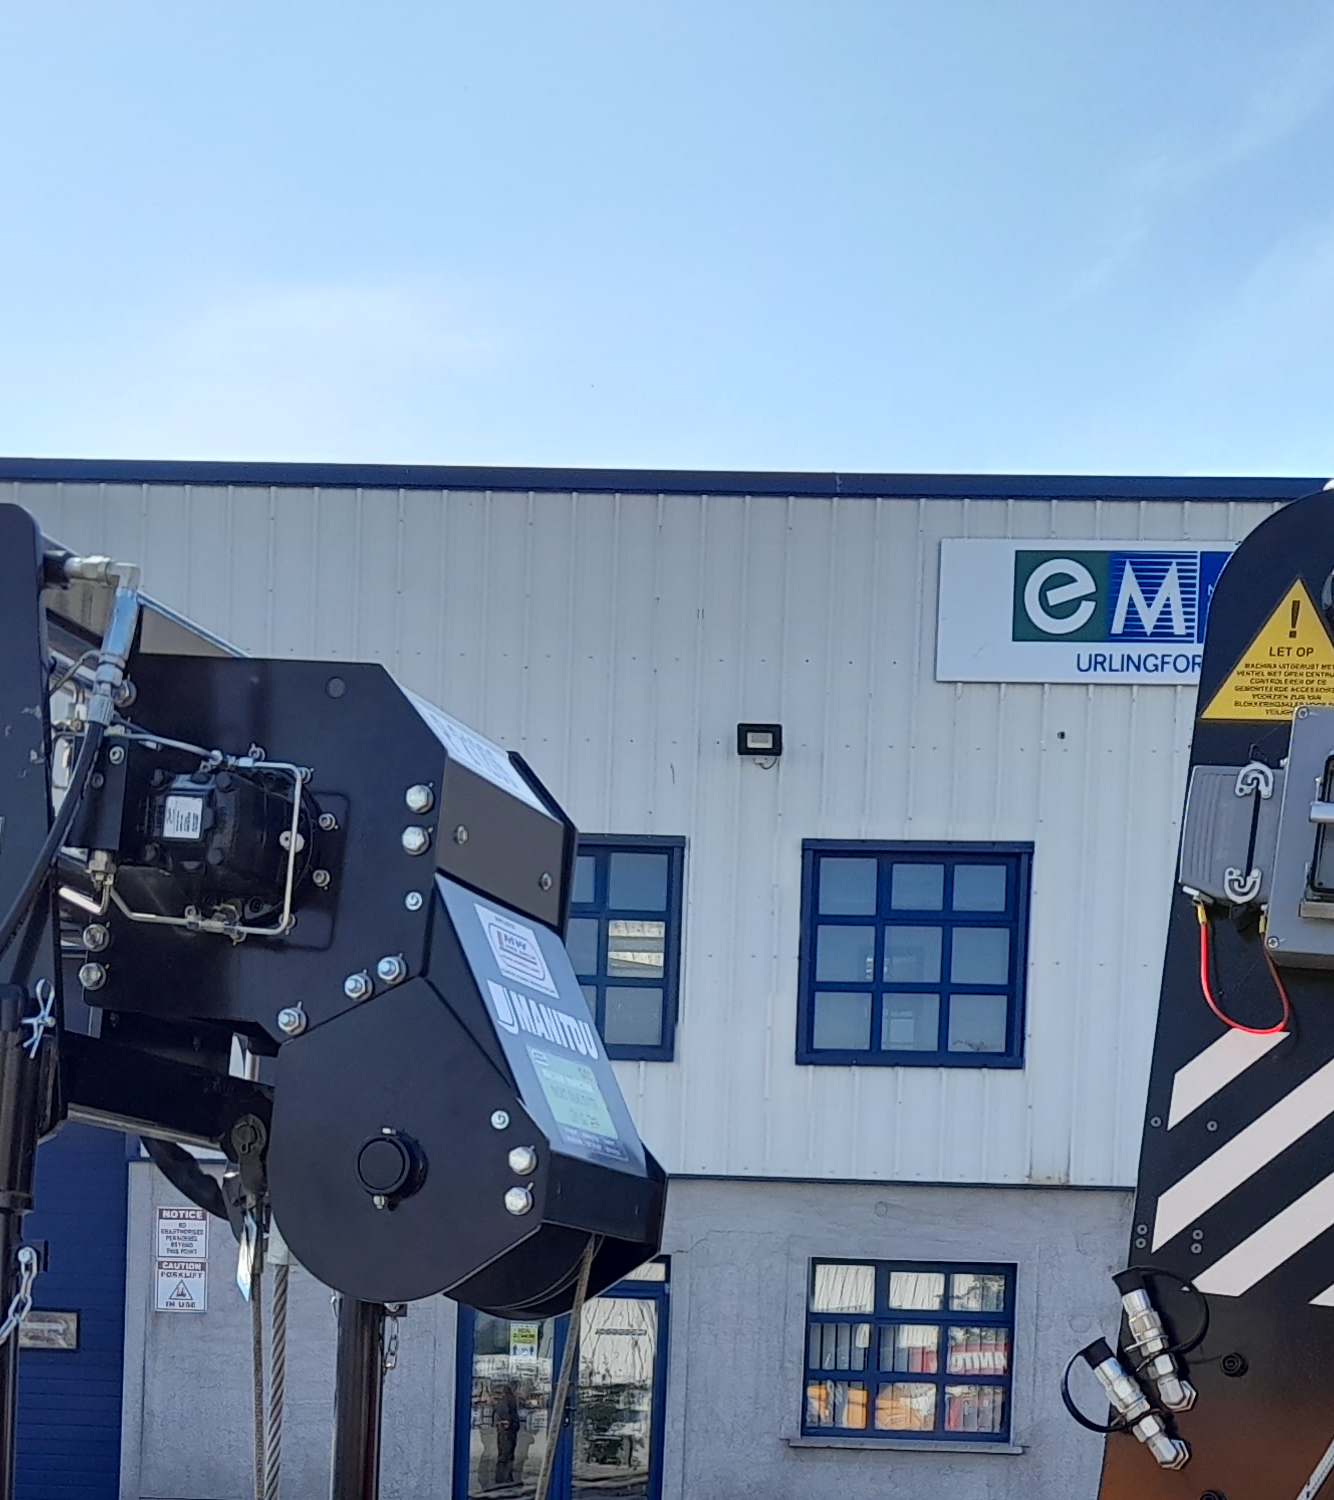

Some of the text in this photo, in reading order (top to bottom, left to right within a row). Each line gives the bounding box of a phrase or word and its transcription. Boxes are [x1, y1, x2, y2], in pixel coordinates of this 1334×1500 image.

[1269, 647, 1314, 657] LET OP
[509, 989, 599, 1060] MANITOU
[163, 1210, 203, 1219] NOTICE
[162, 1262, 202, 1270] CAUTION
